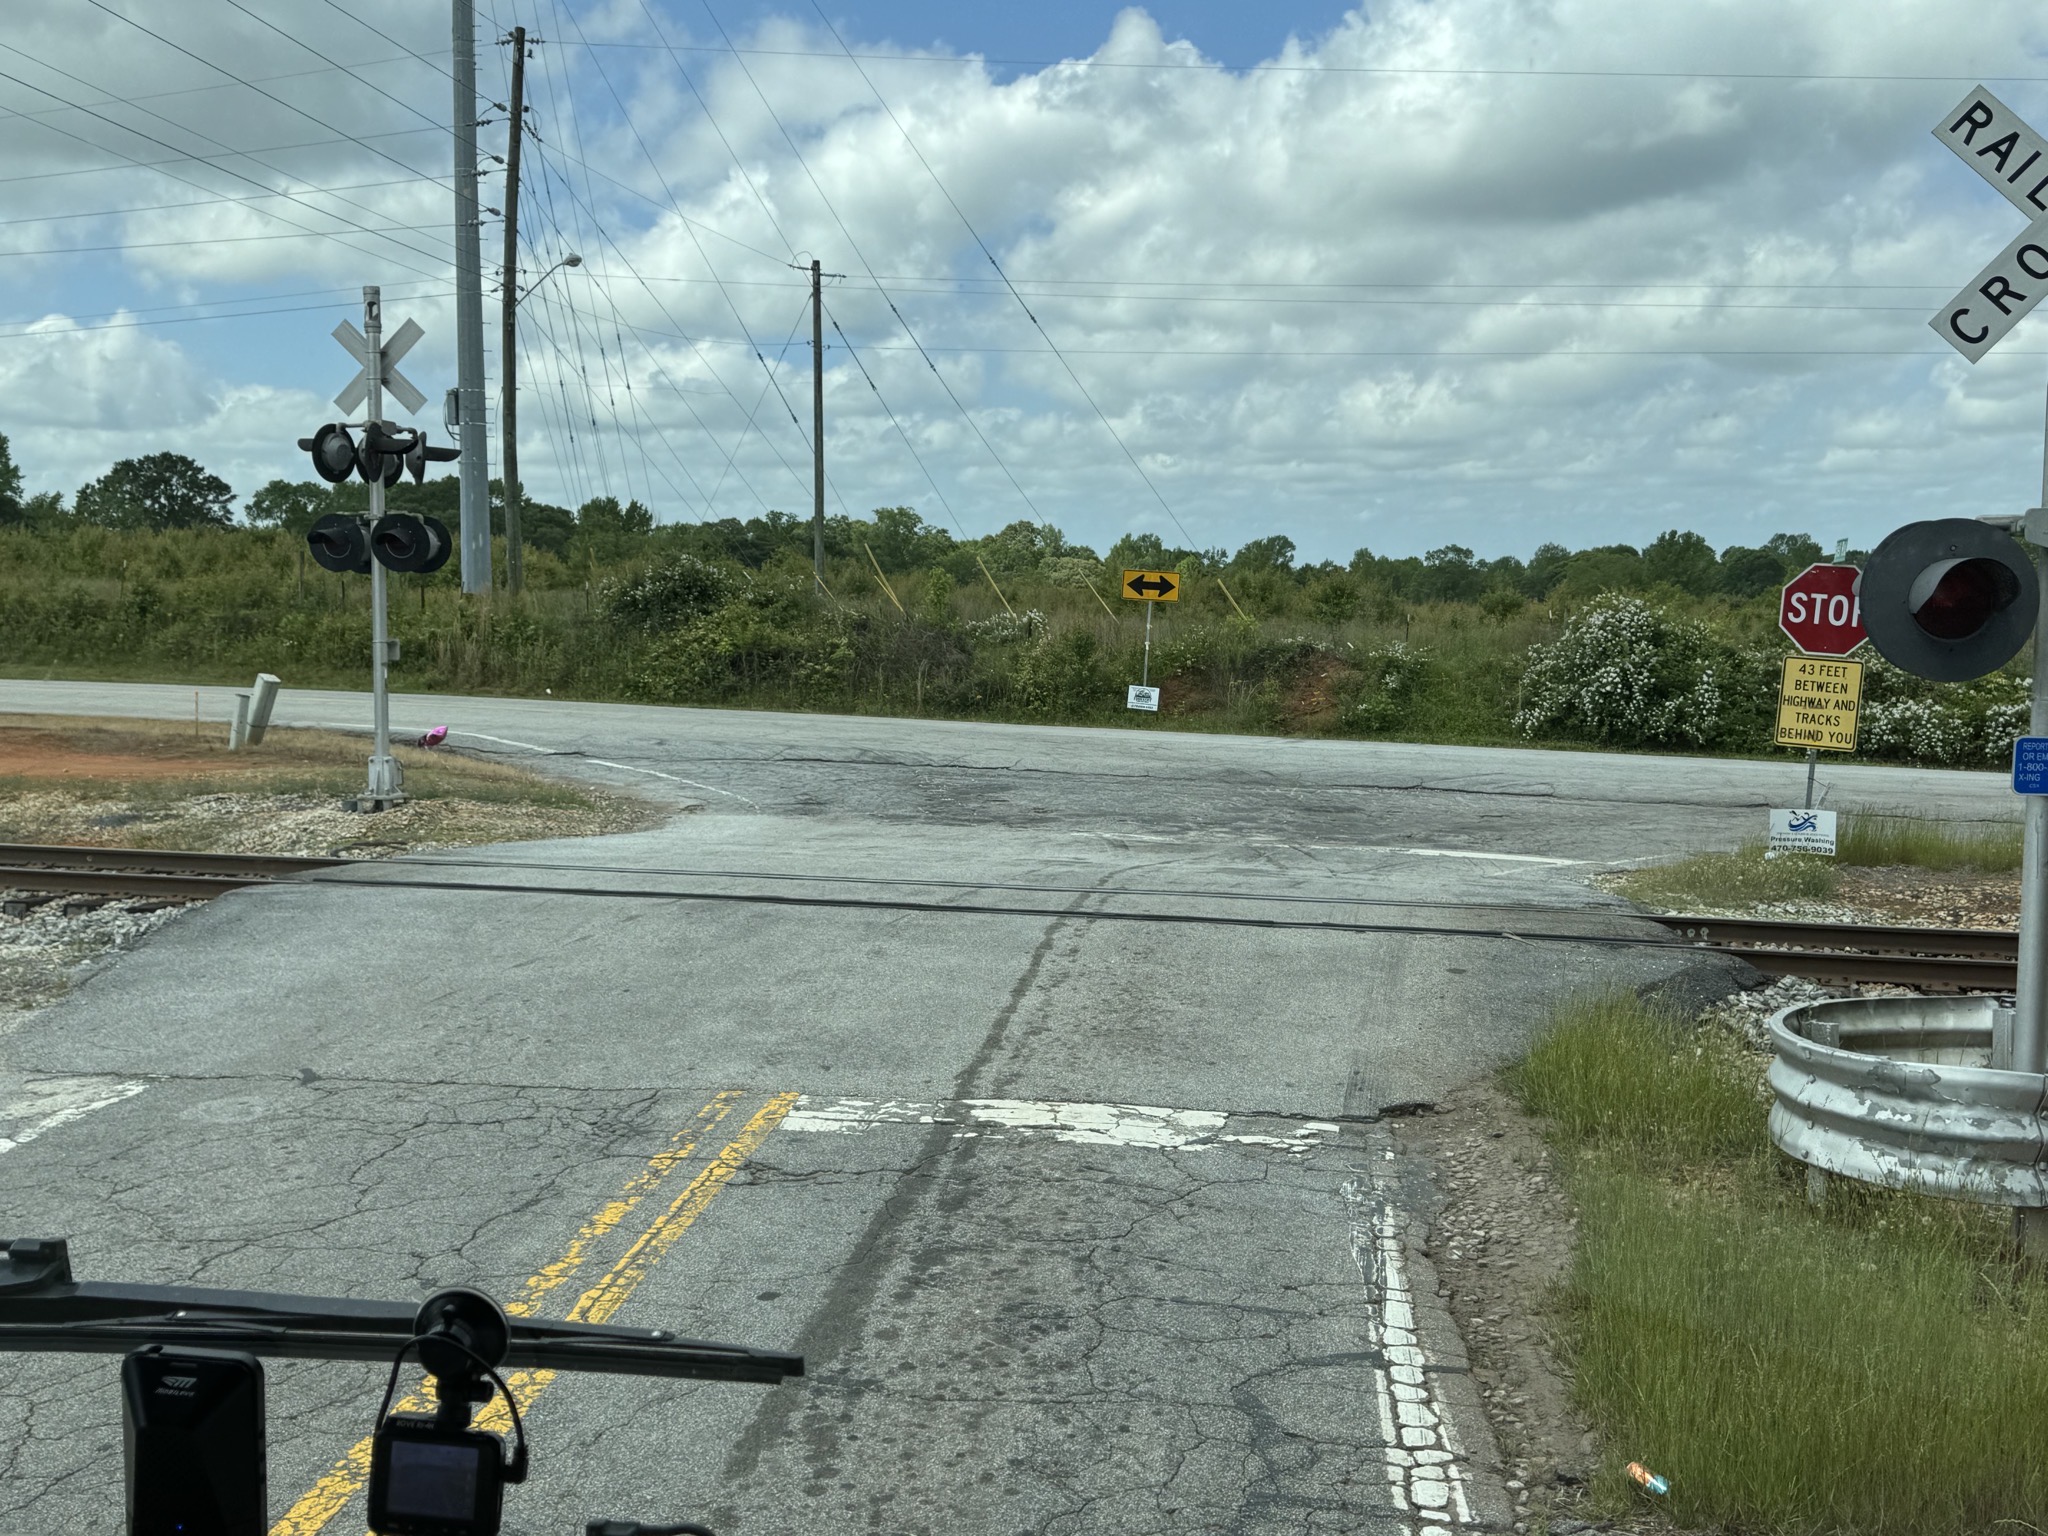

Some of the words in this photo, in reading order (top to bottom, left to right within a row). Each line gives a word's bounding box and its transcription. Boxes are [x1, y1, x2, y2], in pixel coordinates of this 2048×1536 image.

[1798, 663, 1815, 676] 43
[1819, 664, 1848, 678] FEET
[1794, 679, 1848, 694] BETWEEN
[1782, 694, 1831, 710] HIGHWAY
[1833, 700, 1856, 712] AND
[1795, 712, 1841, 727] TRACKS
[1779, 727, 1823, 742] BEHIND
[1828, 731, 1853, 745] YOU
[2022, 752, 2035, 761] OR
[2018, 773, 2041, 782] X-ING
[1770, 835, 1803, 843] Pressure
[1803, 836, 1835, 847] Washing
